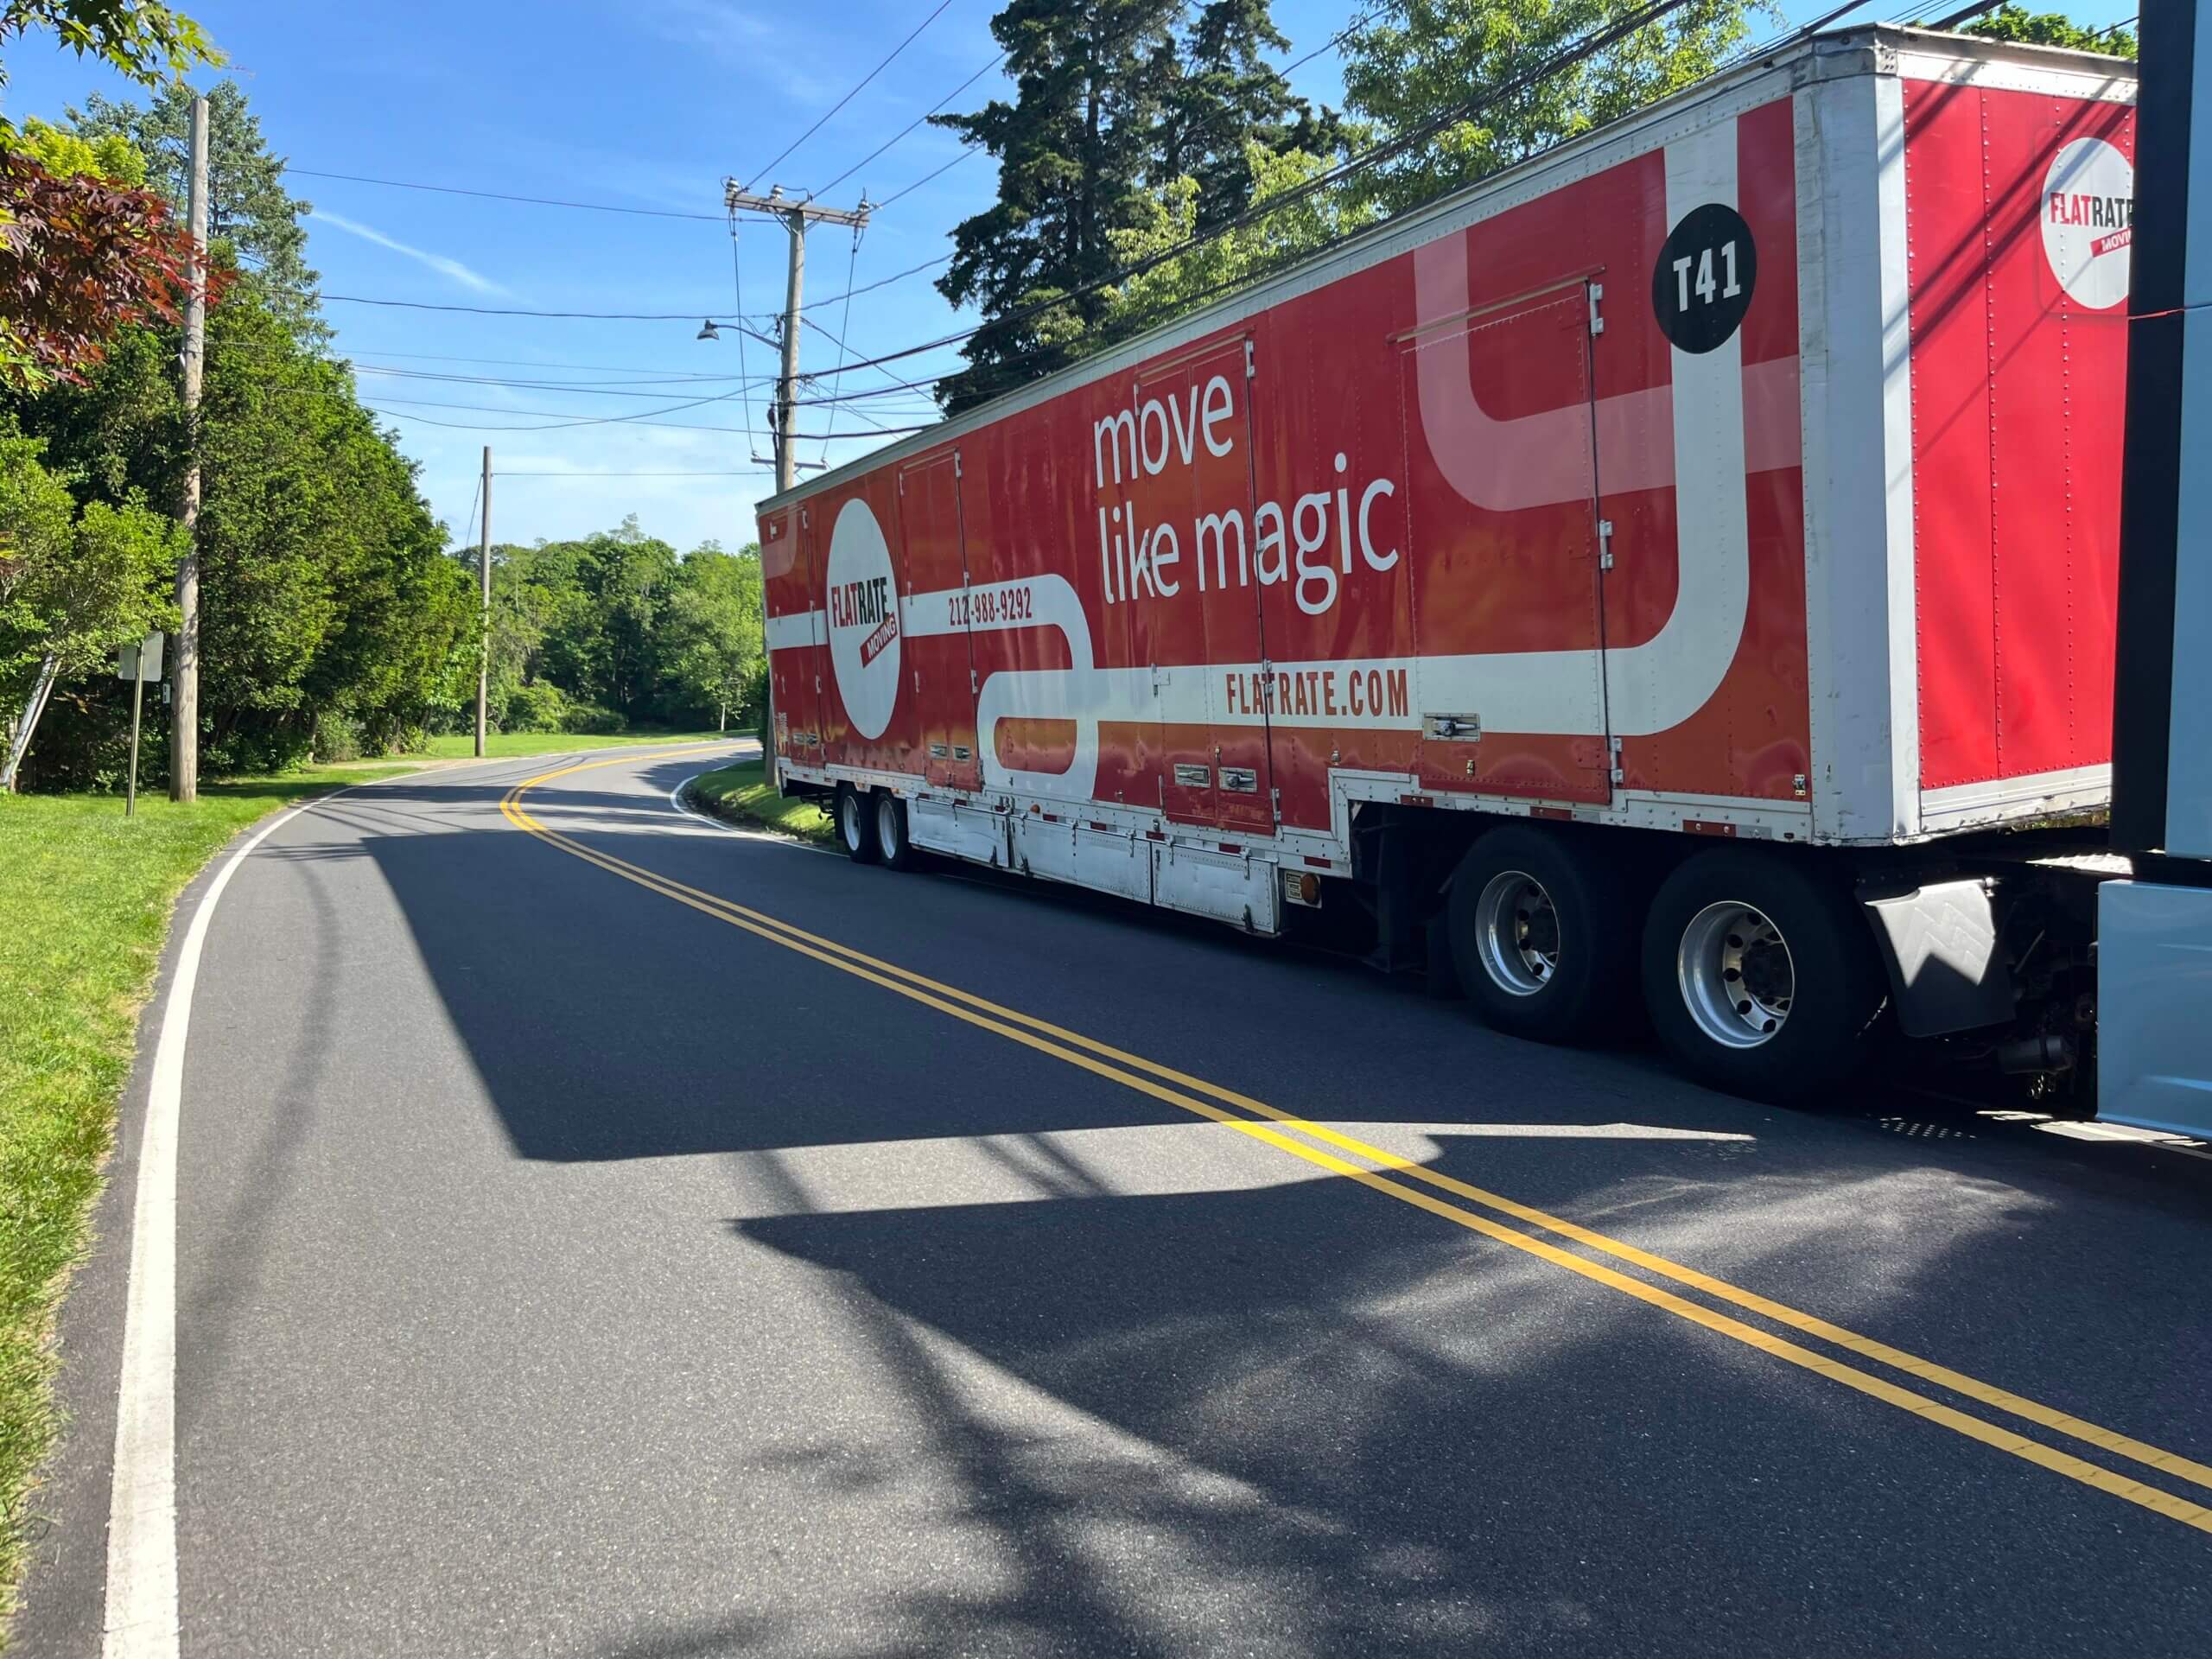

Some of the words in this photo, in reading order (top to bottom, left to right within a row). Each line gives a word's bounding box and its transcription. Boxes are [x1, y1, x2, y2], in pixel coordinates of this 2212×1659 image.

[1673, 240, 1741, 313] T41
[1094, 375, 1233, 489] move
[1099, 500, 1180, 605] like
[1195, 452, 1399, 615] magic
[831, 576, 889, 628] FLATRATE
[949, 587, 1032, 626] 212-988-9292
[867, 616, 896, 658] MOVING
[1226, 669, 1408, 717] FLATRATE.COM
